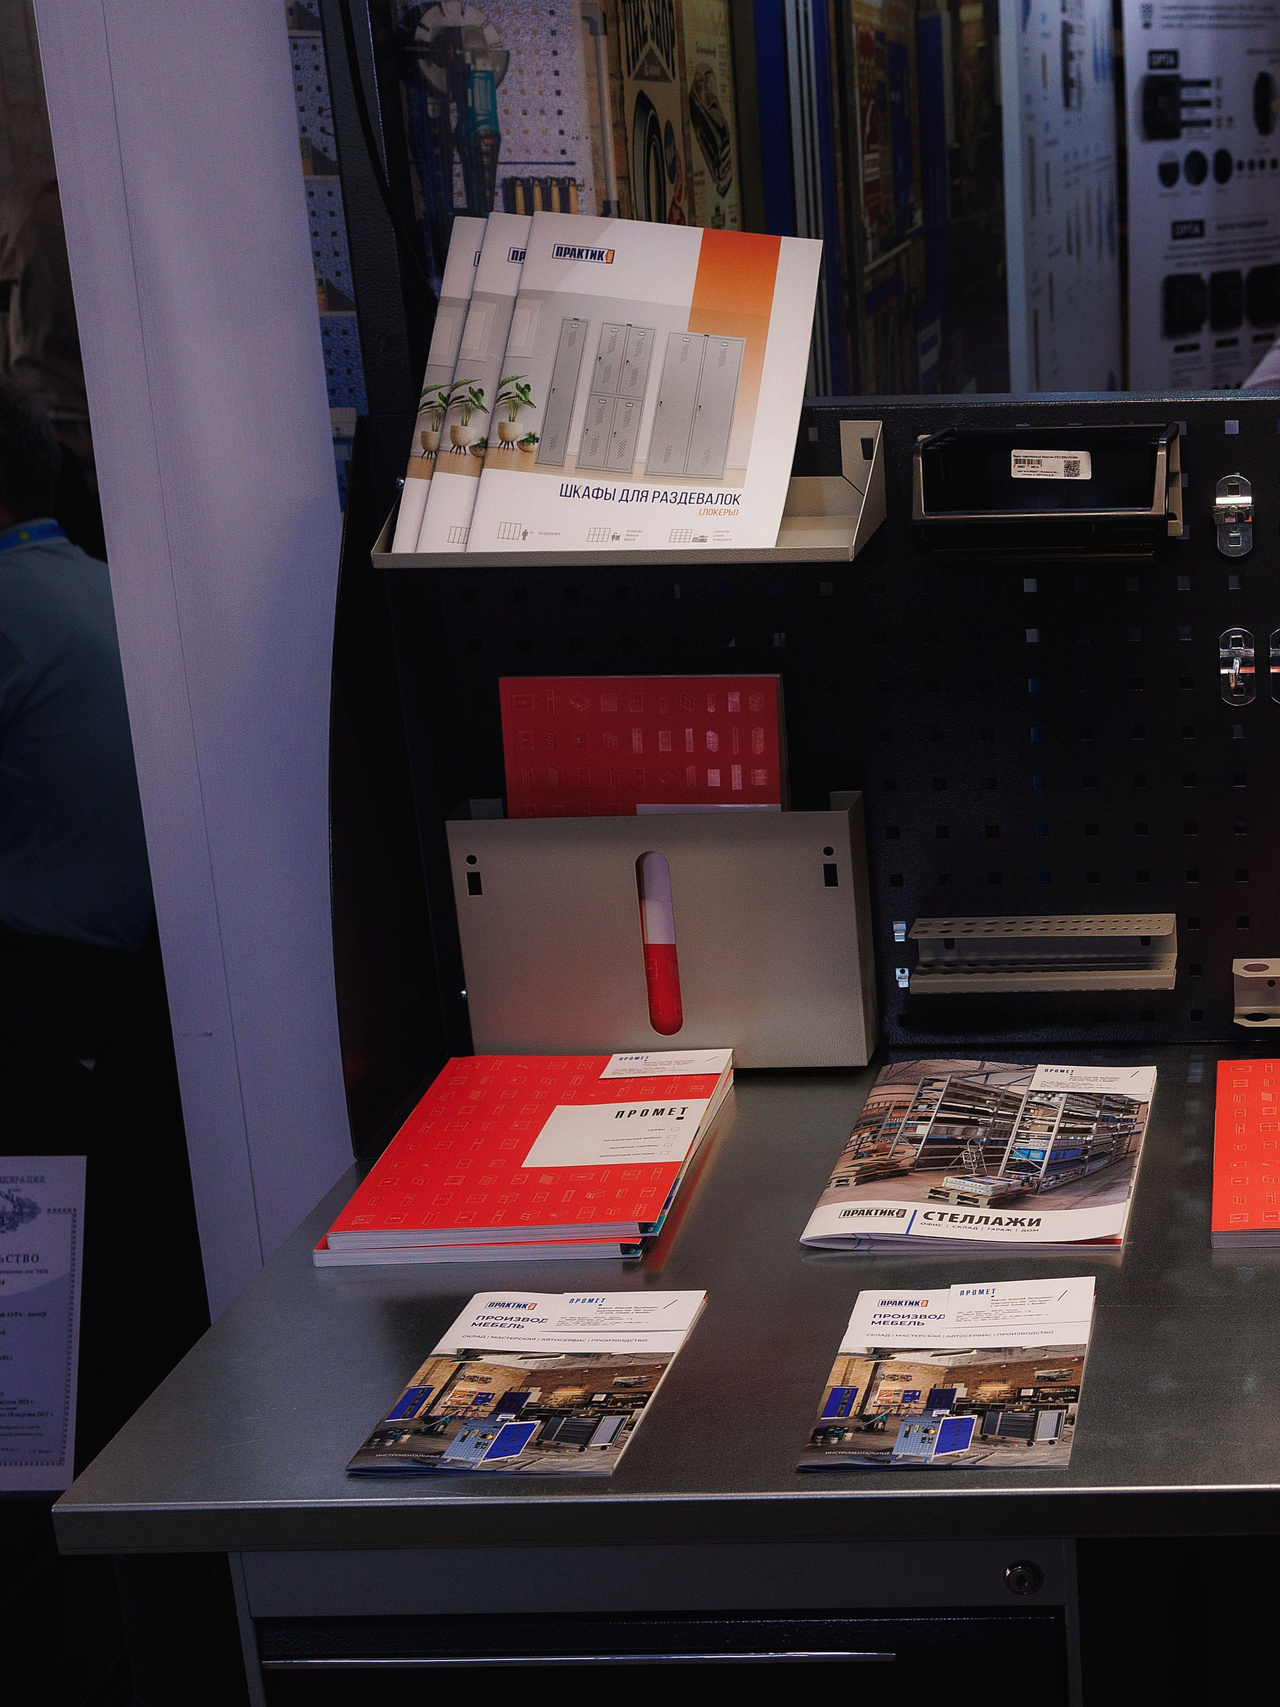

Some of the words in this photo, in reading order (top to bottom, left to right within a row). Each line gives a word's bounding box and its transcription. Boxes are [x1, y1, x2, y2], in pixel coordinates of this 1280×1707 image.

[555, 246, 605, 262] ПРАКТИК
[559, 483, 617, 501] ШКАФЫ
[618, 489, 649, 504] ДЛЯ
[651, 490, 742, 506] РАЗДЕВАЛОК
[614, 1106, 689, 1120] ПРОМЕТ
[843, 1209, 898, 1218] ПРАКТИК
[923, 1211, 1042, 1227] СТЕЛЛАЖИ
[959, 1288, 996, 1298] ПРОМЕТ
[487, 1302, 529, 1310] ПРАКТИК
[569, 1297, 607, 1306] ПРОМЕТ
[475, 1315, 549, 1324] ПРОИЗВОД
[470, 1322, 525, 1330] МЕБЕЛЬ
